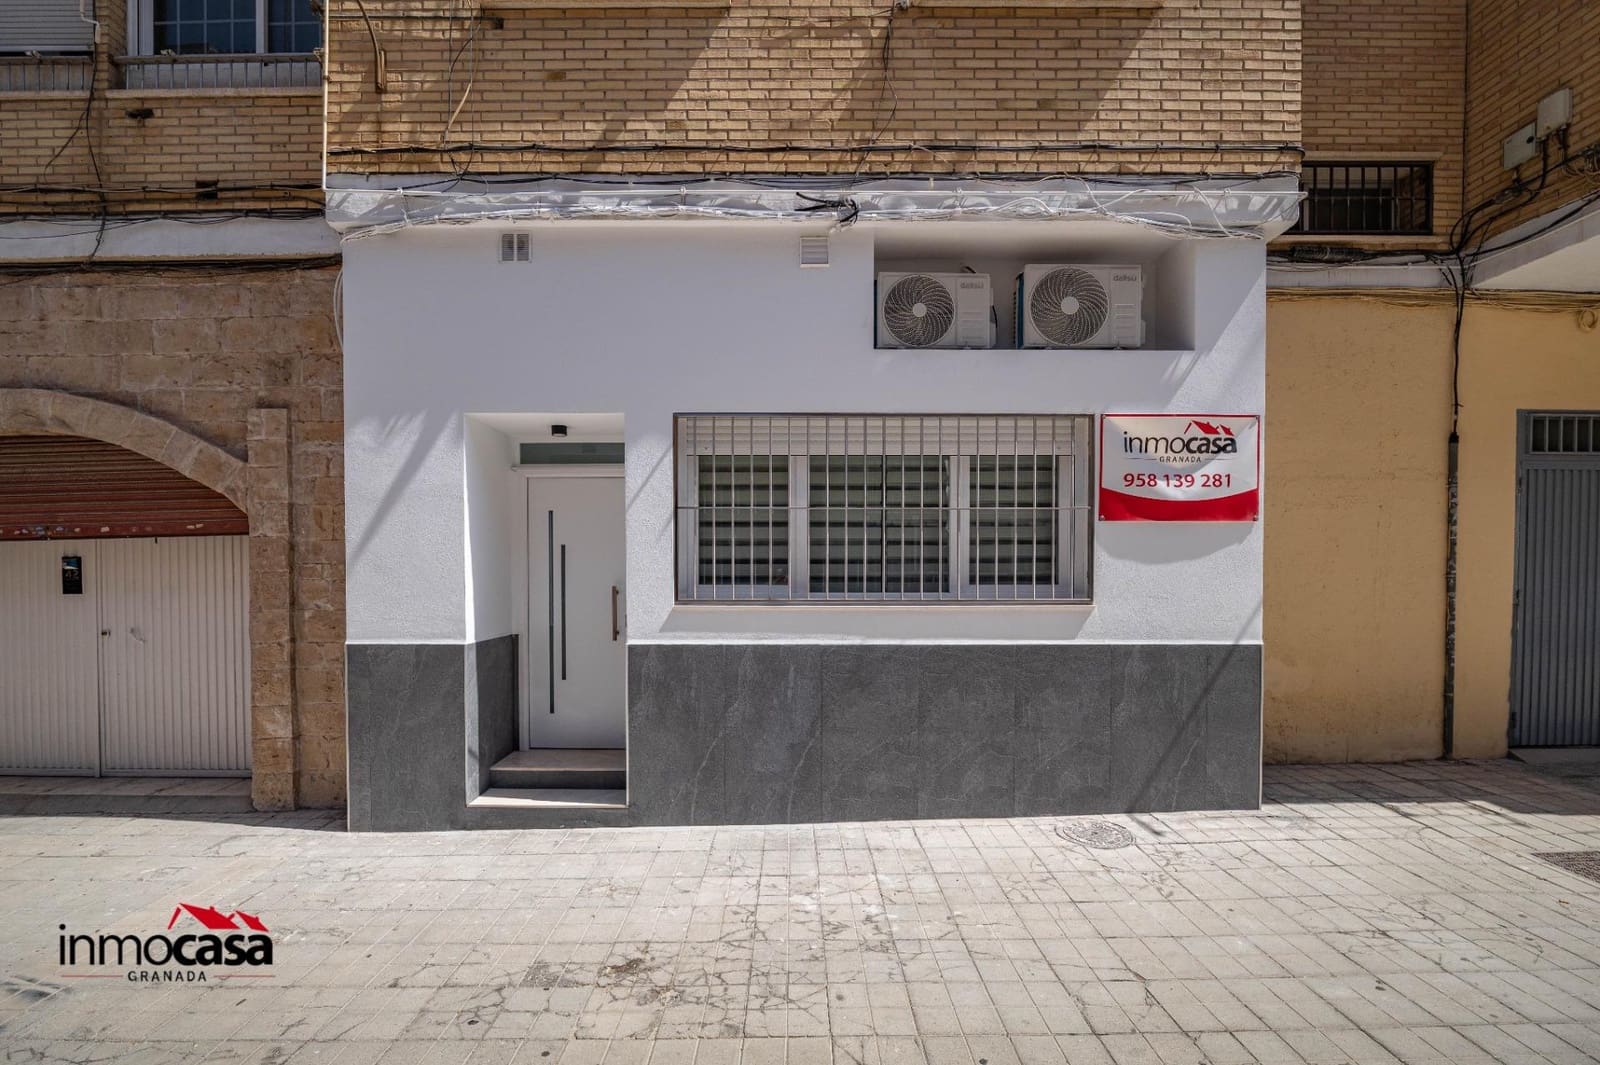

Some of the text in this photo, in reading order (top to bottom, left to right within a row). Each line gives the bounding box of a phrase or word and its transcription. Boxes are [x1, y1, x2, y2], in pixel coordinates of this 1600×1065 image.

[1124, 431, 1237, 454] inmocasa
[1123, 473, 1232, 488] 958 139 281
